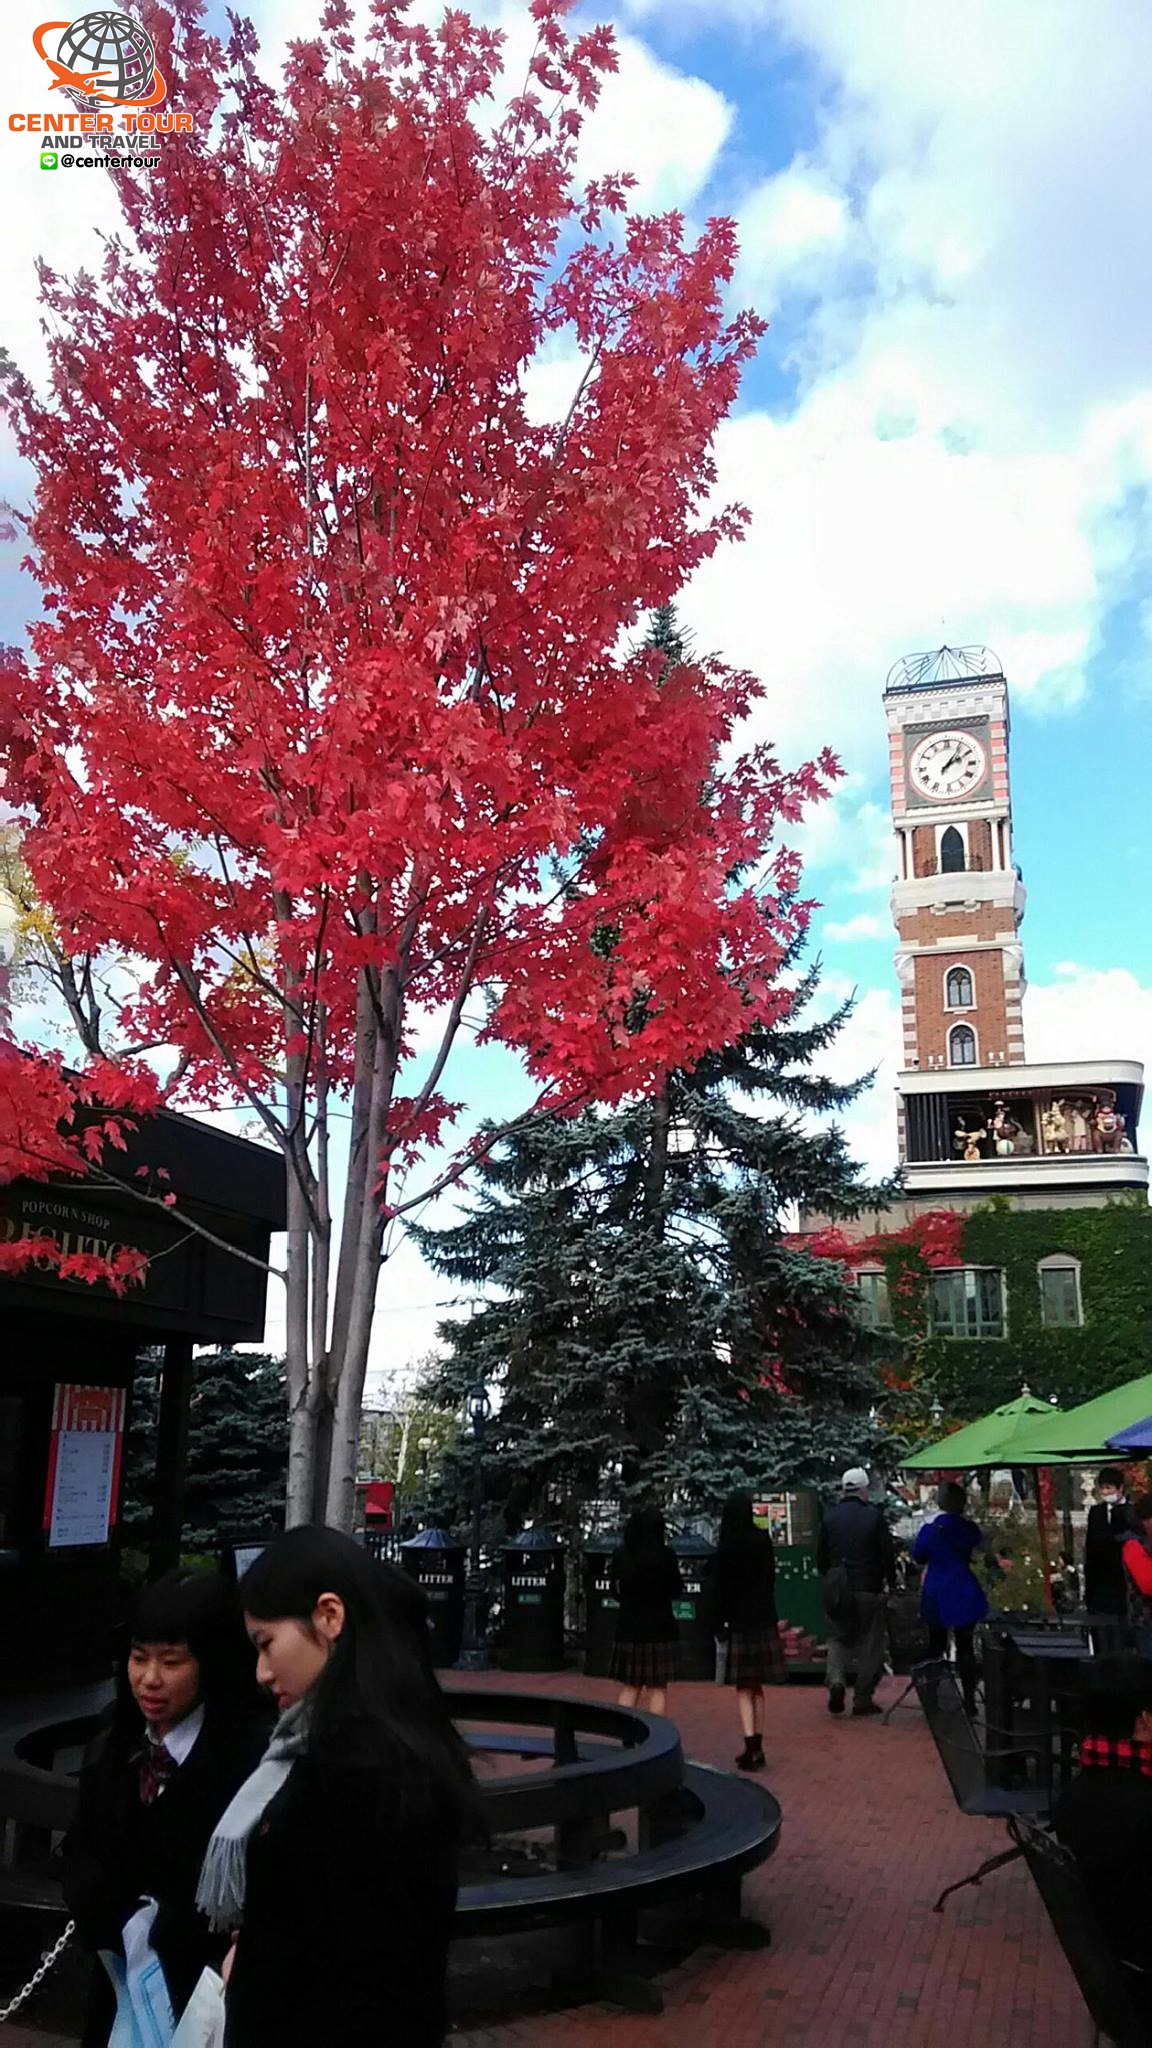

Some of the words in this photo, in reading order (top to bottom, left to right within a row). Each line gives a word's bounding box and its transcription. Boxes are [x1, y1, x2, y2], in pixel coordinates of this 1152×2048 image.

[21, 1200, 78, 1219] POPCORN
[80, 1211, 111, 1230] SHOP
[418, 1573, 454, 1584] LITTER
[511, 1576, 547, 1587] LITTER
